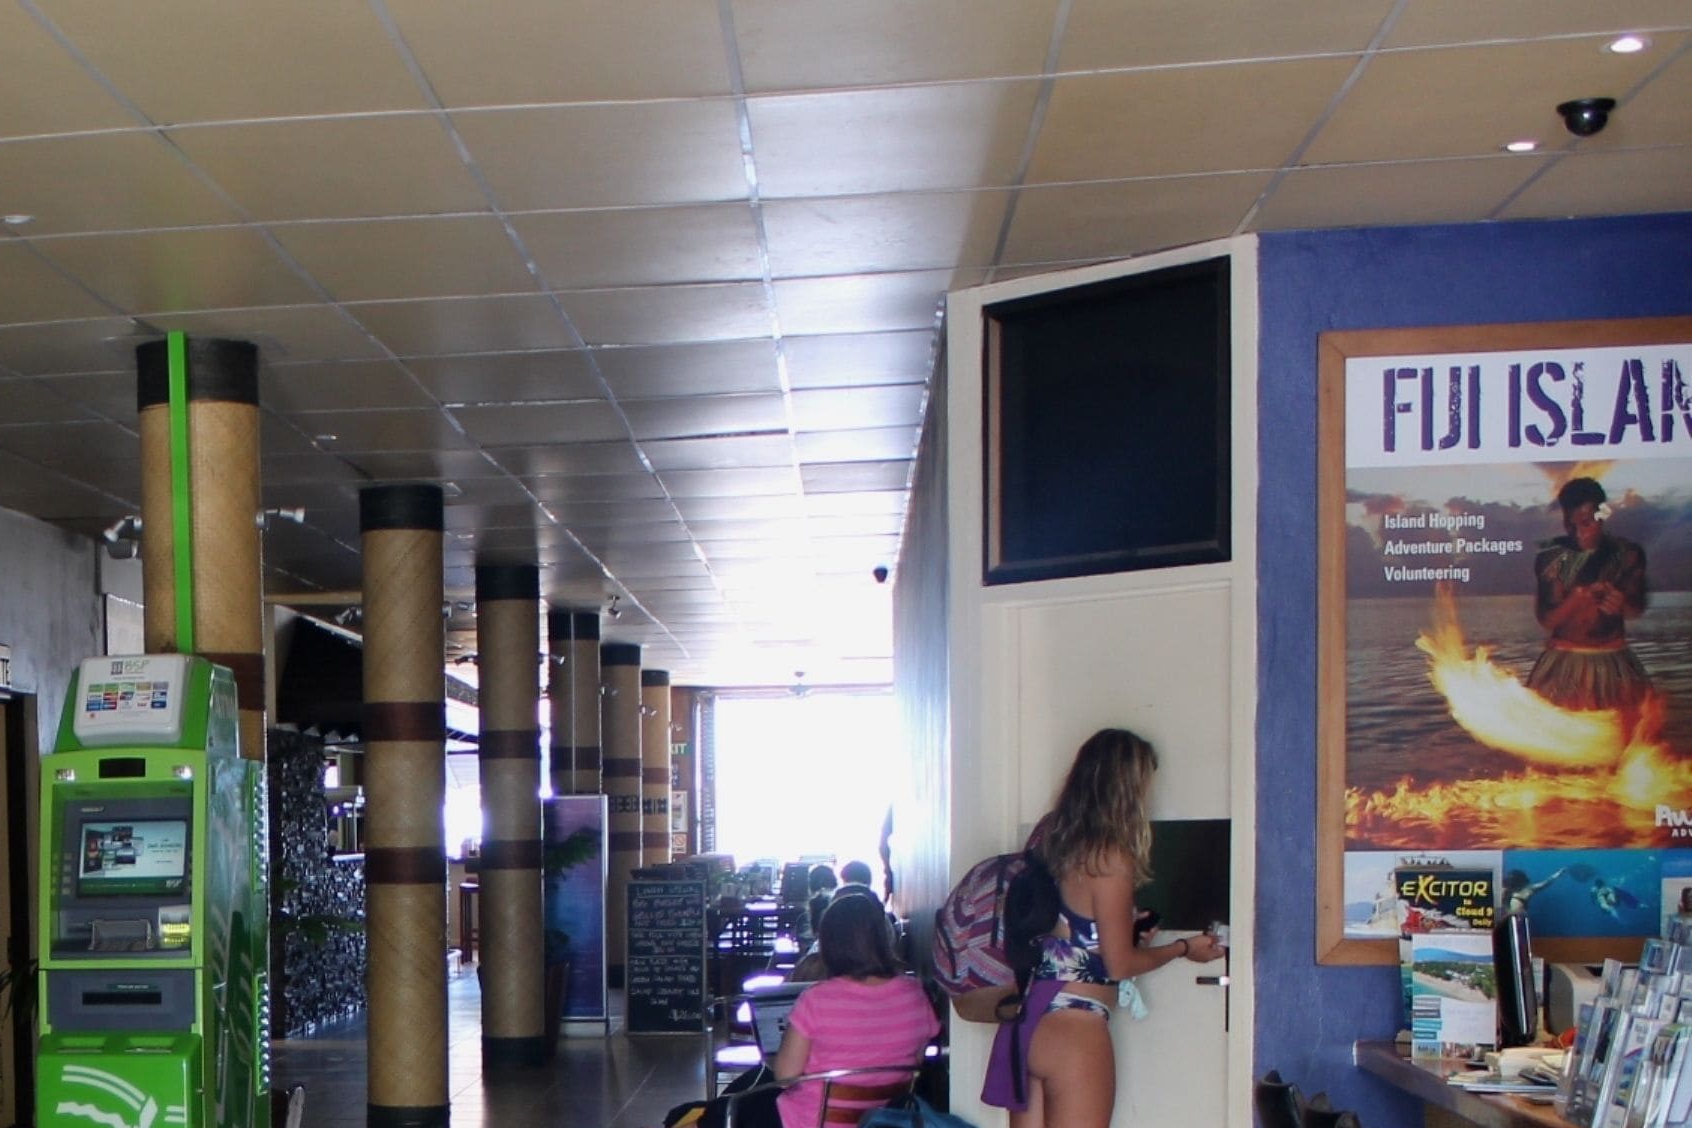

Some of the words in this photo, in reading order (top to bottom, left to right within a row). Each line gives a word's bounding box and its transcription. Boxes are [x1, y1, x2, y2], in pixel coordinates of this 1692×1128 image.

[1382, 363, 1481, 453] FIJI
[1385, 513, 1426, 530] Island
[1428, 512, 1486, 531] Hopping
[1384, 540, 1453, 556] Adventure
[1456, 538, 1523, 556] Packages
[1384, 565, 1470, 583] Volunteering
[1400, 874, 1489, 905] EXCITOR
[1455, 906, 1485, 917] Cloud
[1486, 906, 1493, 917] 9
